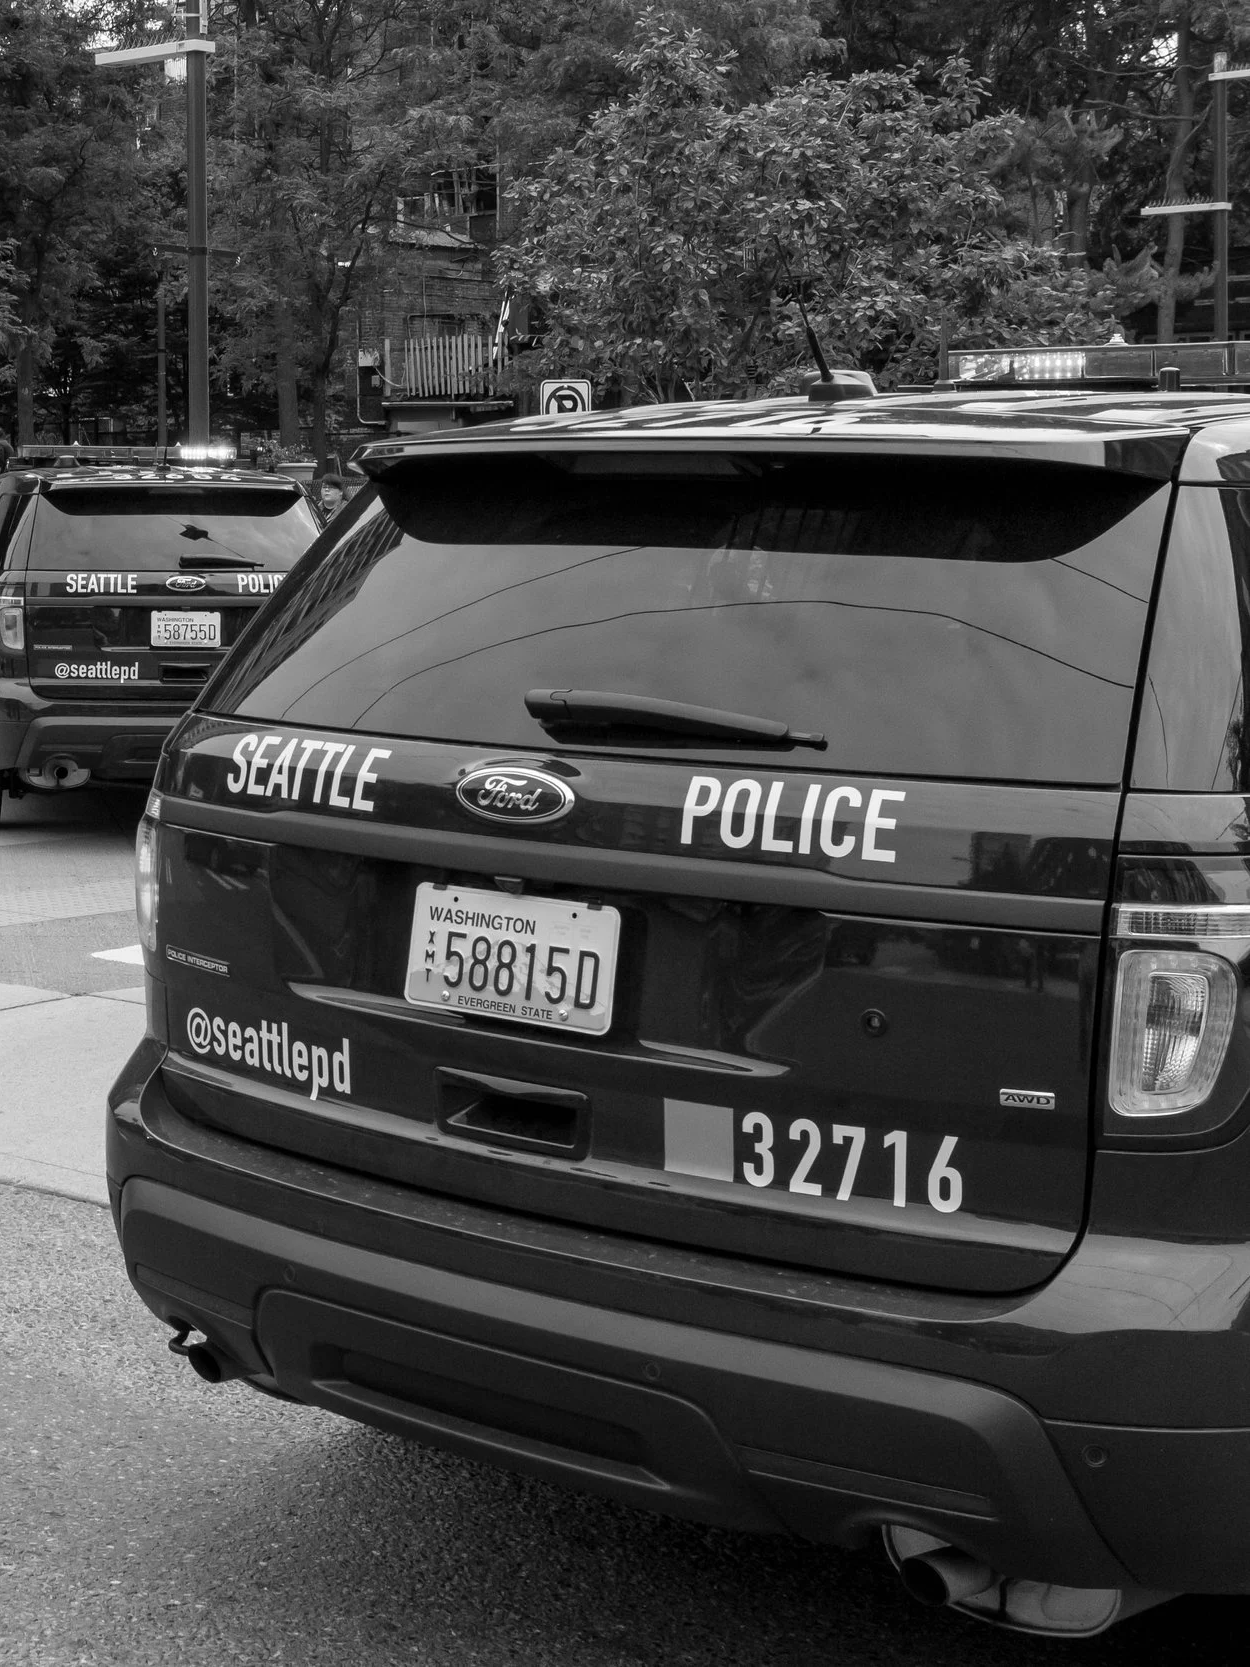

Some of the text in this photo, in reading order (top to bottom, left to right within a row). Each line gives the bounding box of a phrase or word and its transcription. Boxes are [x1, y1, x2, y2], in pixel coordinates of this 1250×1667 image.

[66, 574, 138, 593] SEATTLE
[164, 624, 216, 640] 58755D
[55, 661, 139, 683] @seattlepd
[226, 734, 392, 812] SEATTLE
[680, 776, 907, 864] POLICE
[429, 906, 536, 935] WASHINGTON
[168, 949, 228, 973] POLICE INTERCEPTOR
[443, 931, 600, 1010] 58815D
[457, 995, 553, 1020] EVERGREEN STATE
[187, 1007, 352, 1100] @seattlepd
[1004, 1094, 1050, 1105] AWD
[742, 1111, 963, 1213] 32716
